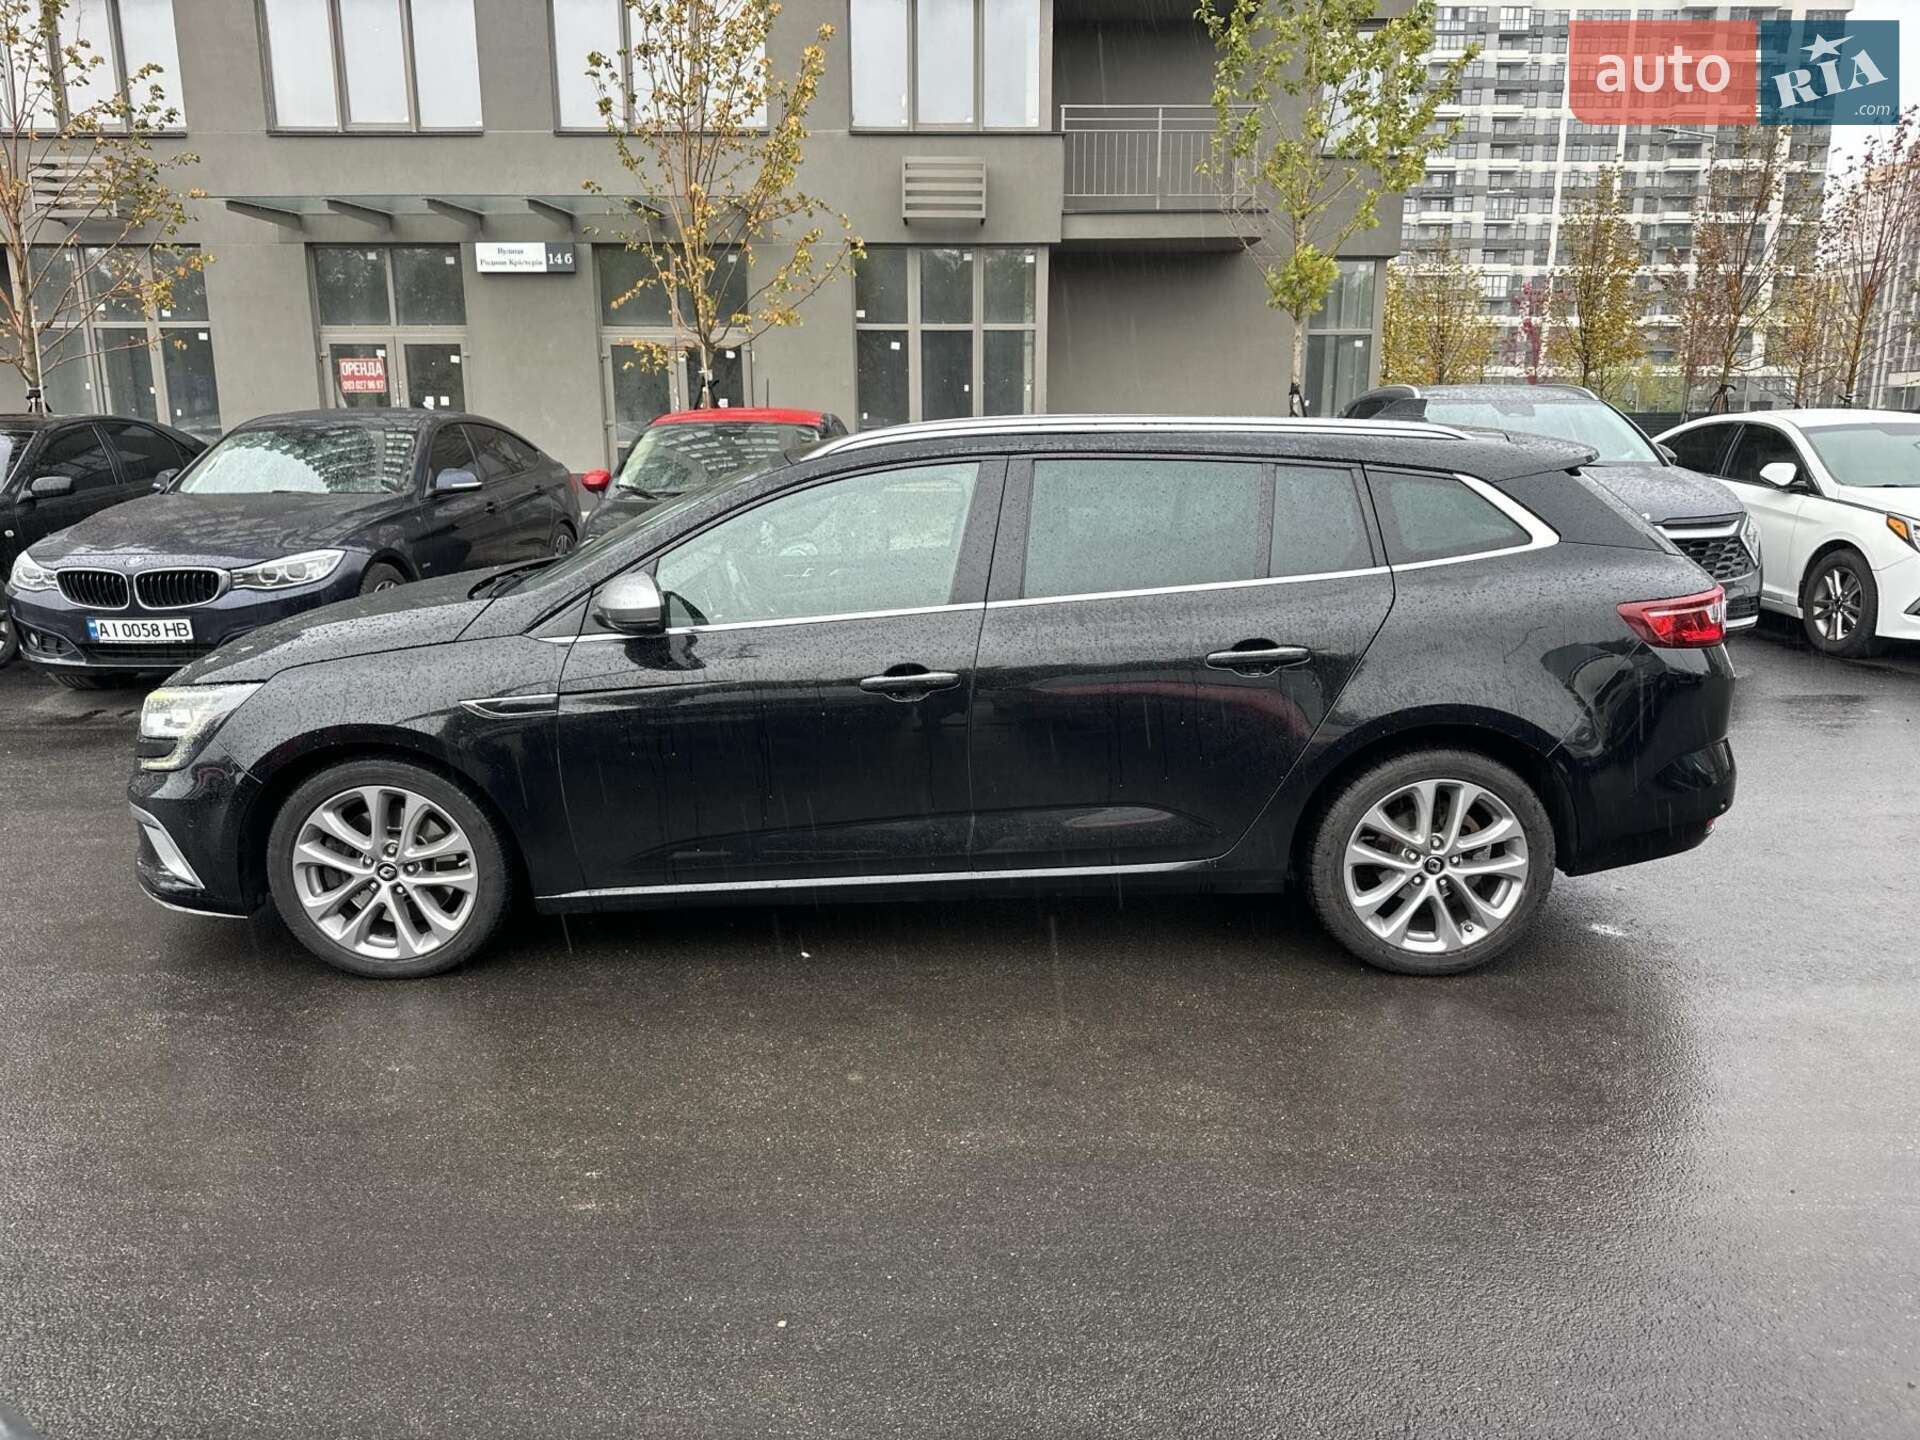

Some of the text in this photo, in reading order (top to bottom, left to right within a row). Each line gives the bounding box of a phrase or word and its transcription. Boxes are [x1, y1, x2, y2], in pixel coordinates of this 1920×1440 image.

[341, 361, 384, 377] ОРЕНДА
[99, 622, 119, 638] AI
[121, 623, 161, 638] 0058
[163, 622, 190, 638] HB
